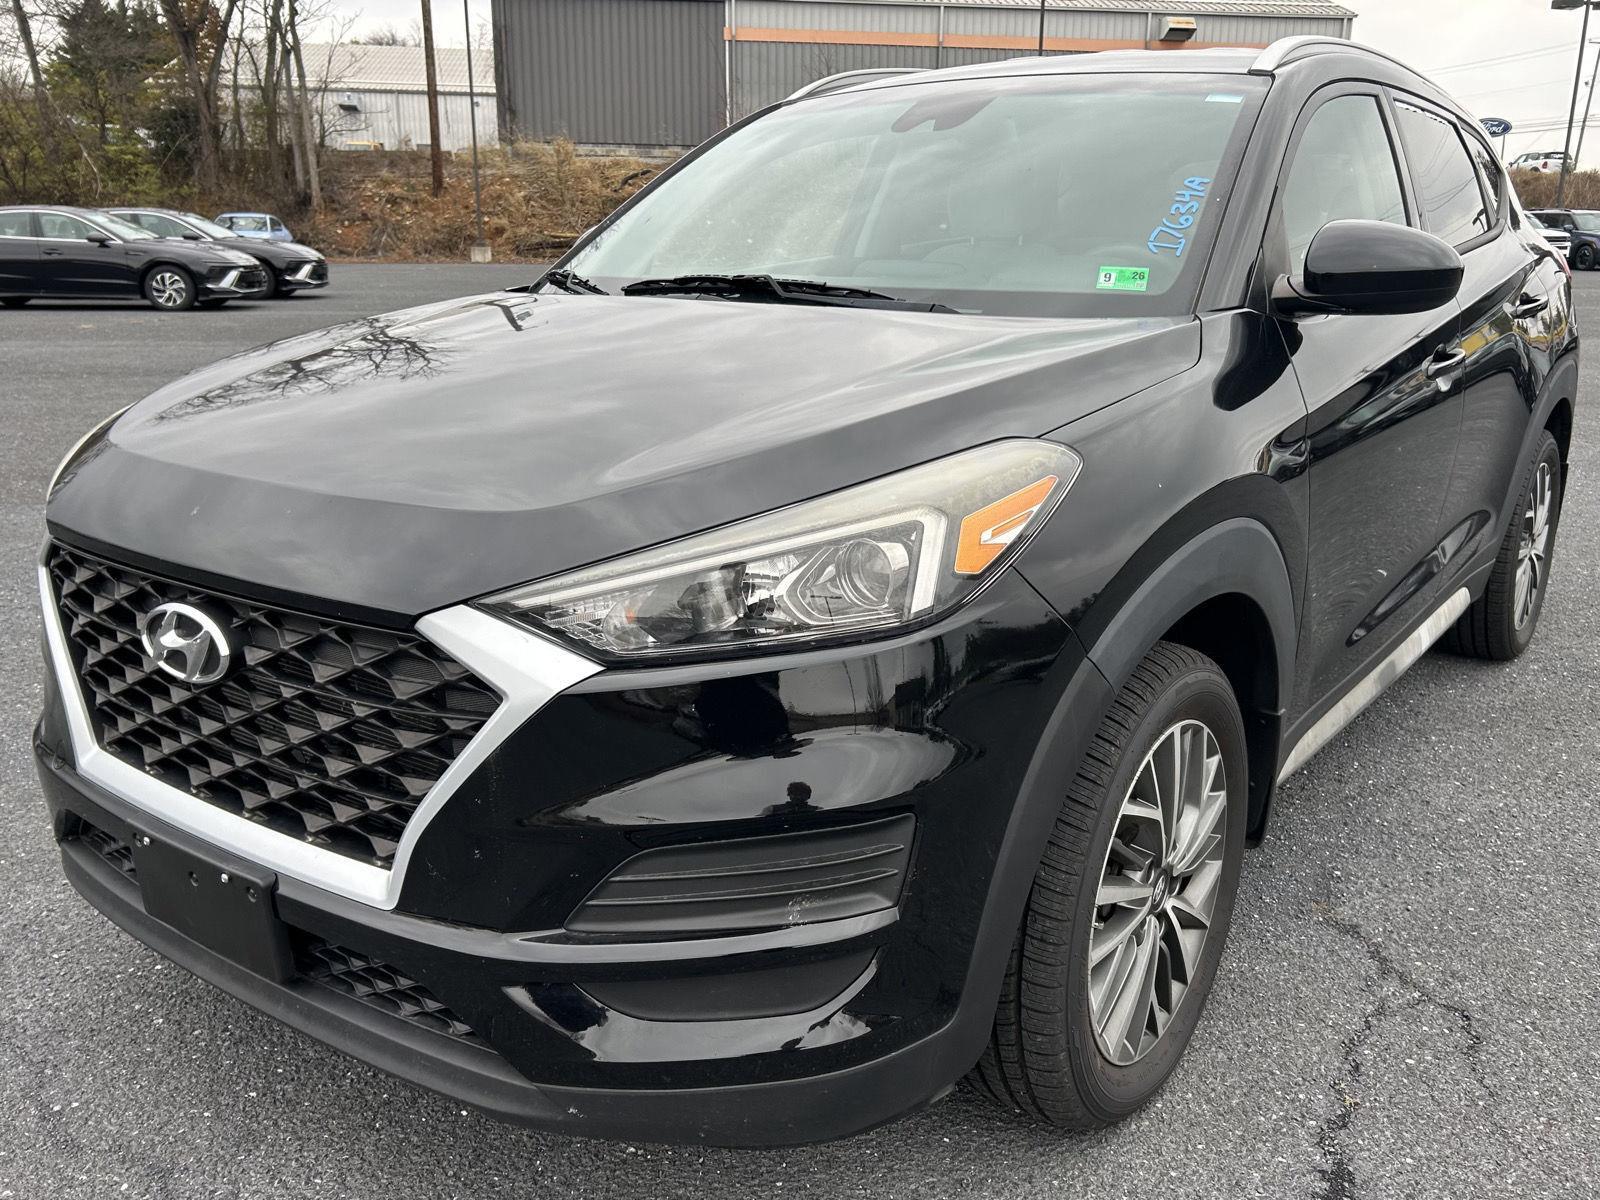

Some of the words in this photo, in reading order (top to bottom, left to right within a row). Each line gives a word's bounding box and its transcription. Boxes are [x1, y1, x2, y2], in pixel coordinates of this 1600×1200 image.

[1483, 121, 1505, 133] Ford
[1148, 176, 1211, 257] 17634A
[1103, 272, 1112, 282] 9
[1131, 271, 1145, 280] 26
